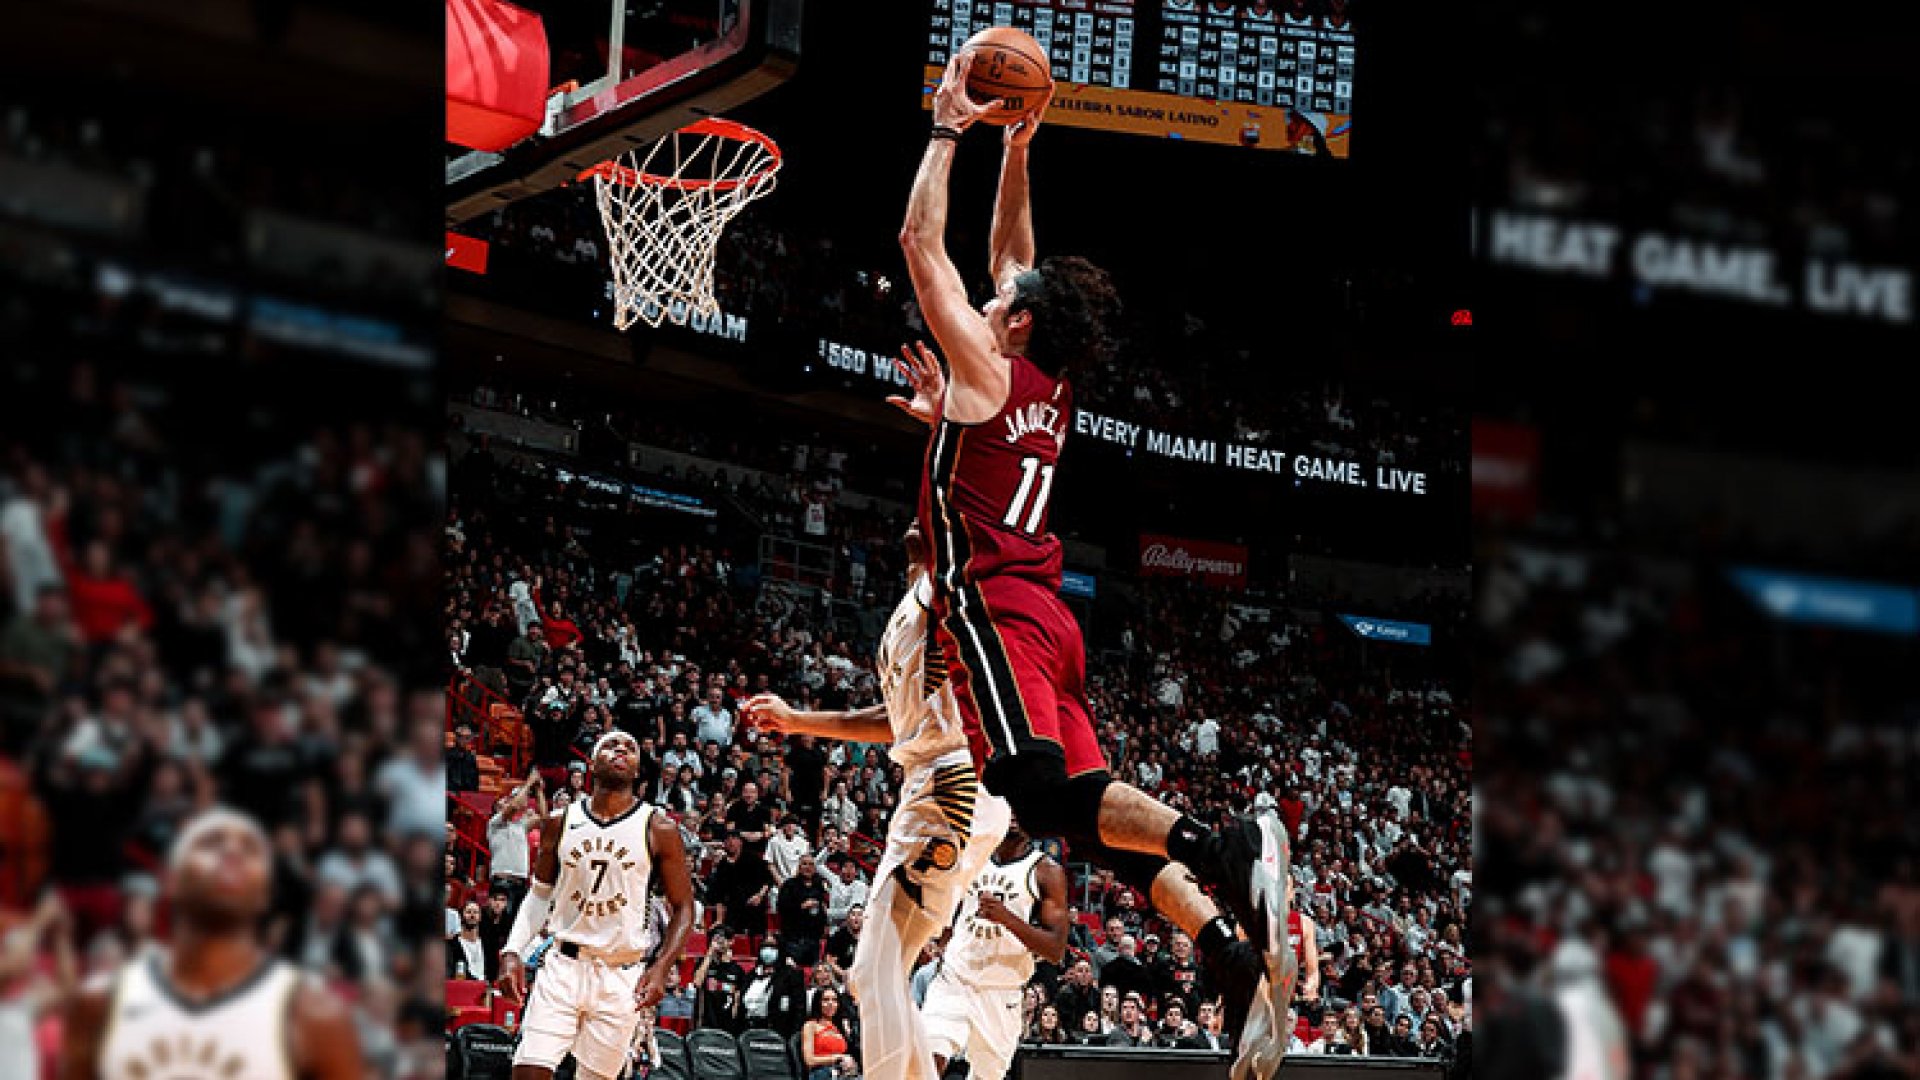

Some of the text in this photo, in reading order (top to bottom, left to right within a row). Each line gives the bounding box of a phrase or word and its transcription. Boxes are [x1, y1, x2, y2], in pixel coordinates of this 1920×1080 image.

[1168, 110, 1219, 128] LATINO
[1074, 408, 1142, 448] EVERY
[1146, 428, 1217, 464] MIAMI
[1225, 443, 1287, 475] HEAT
[1294, 454, 1368, 488] GAME.
[1376, 465, 1427, 495] LIVE
[1002, 456, 1055, 535] 11
[589, 859, 609, 894] 7
